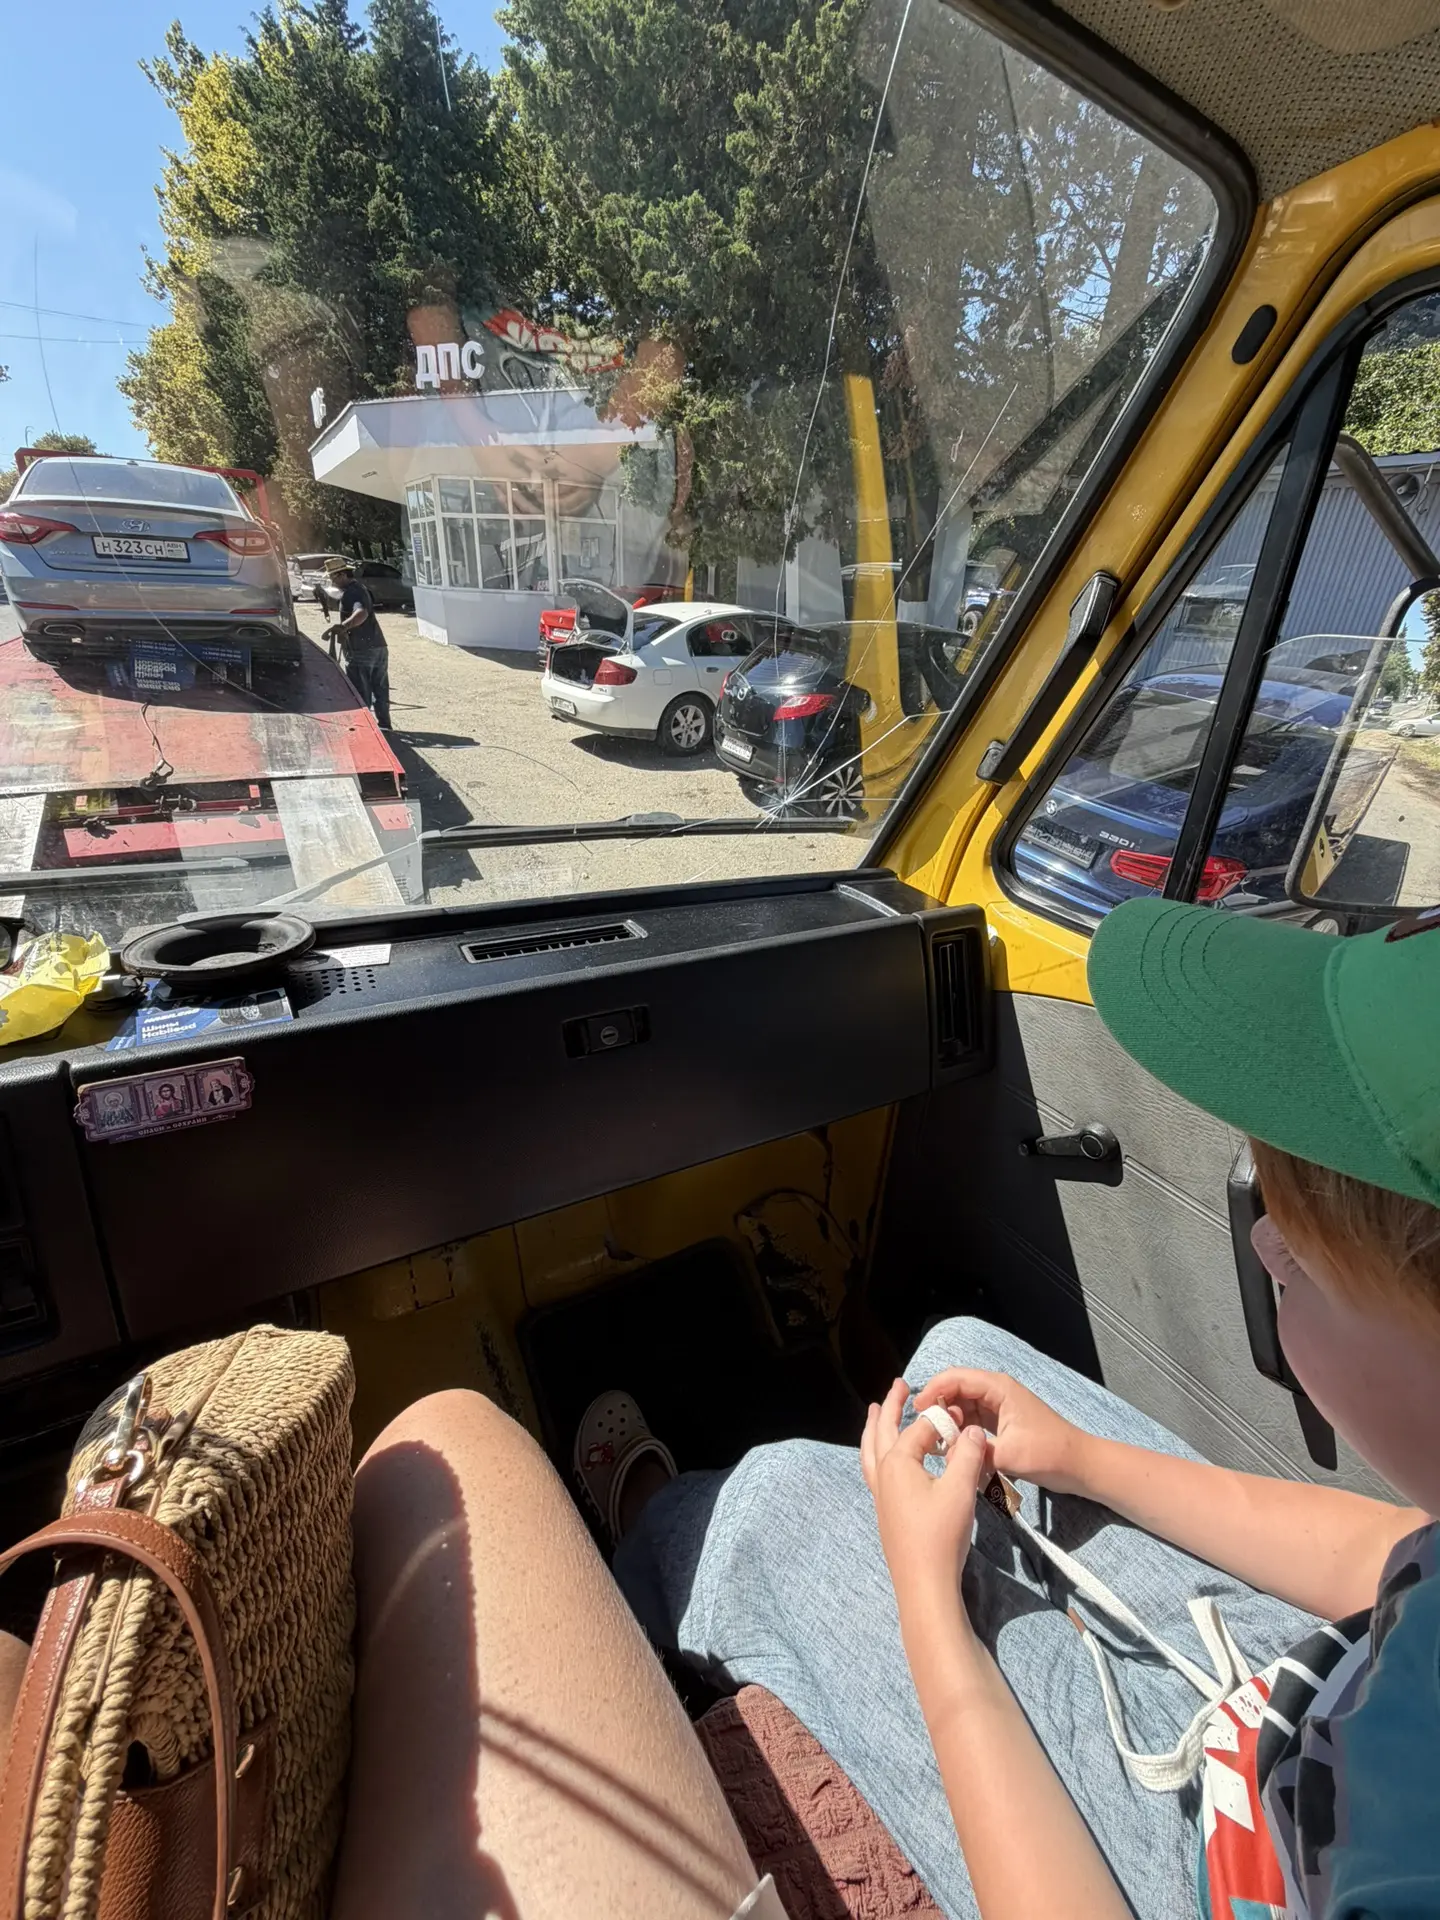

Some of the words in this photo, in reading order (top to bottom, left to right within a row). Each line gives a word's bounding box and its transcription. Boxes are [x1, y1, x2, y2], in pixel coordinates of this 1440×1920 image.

[415, 340, 486, 390] ДПС
[141, 1021, 179, 1033] Шины
[142, 1022, 197, 1039] Habilead
